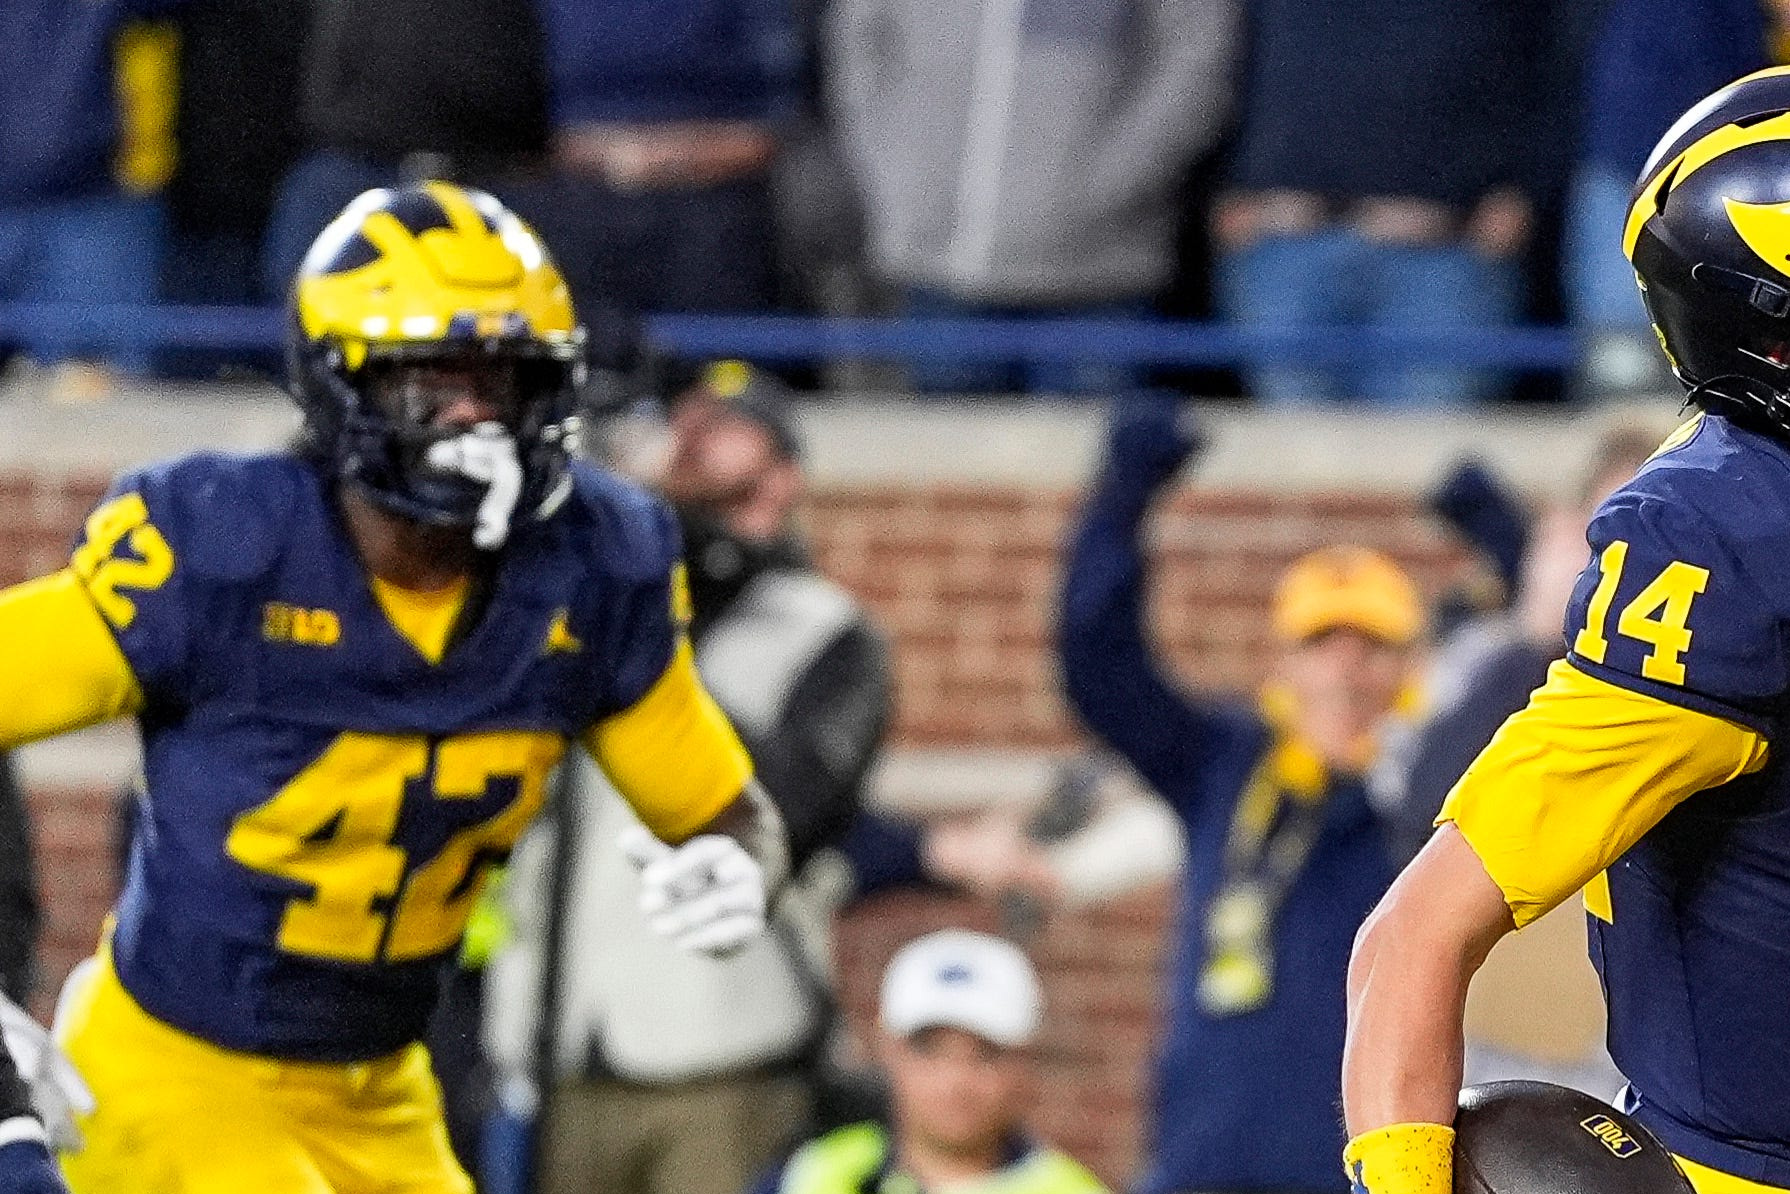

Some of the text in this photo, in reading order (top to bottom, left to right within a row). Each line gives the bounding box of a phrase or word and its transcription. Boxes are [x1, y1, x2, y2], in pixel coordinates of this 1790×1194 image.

[72, 490, 176, 632] 42
[1573, 539, 1711, 686] 14
[224, 730, 565, 962] 42
